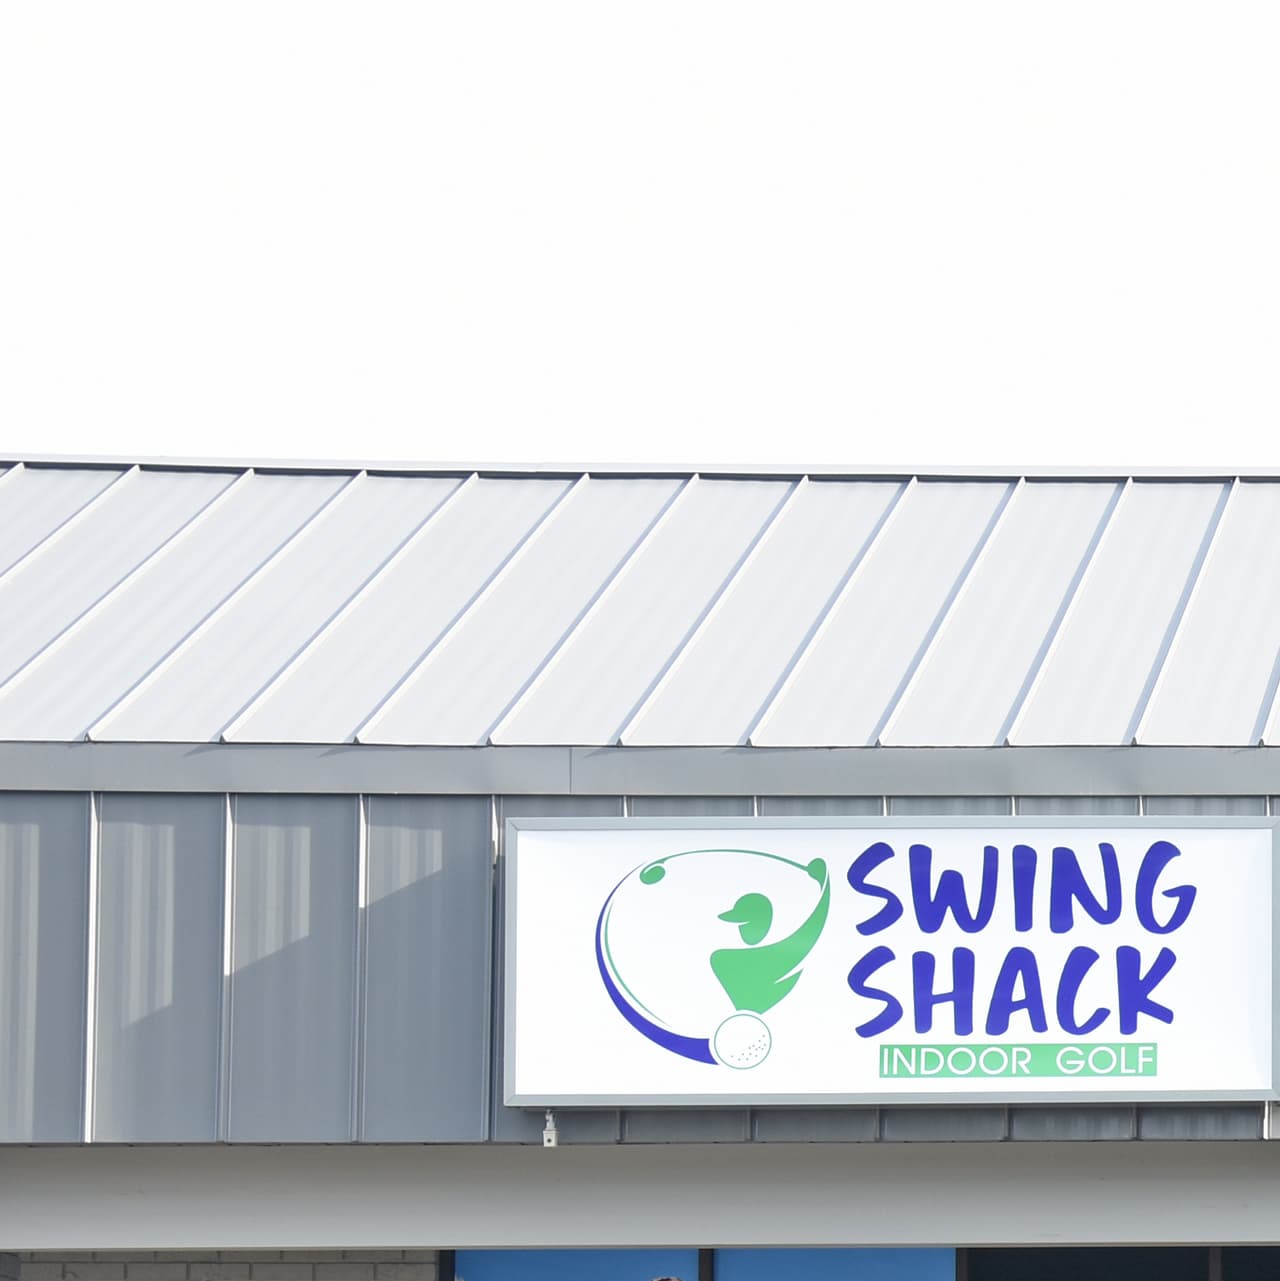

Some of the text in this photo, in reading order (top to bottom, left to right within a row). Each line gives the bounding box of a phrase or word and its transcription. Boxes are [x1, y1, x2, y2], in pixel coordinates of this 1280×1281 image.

[846, 841, 1197, 936] SWING
[846, 945, 1177, 1038] SHACK
[882, 1045, 1154, 1075] INDOOR GOLF
